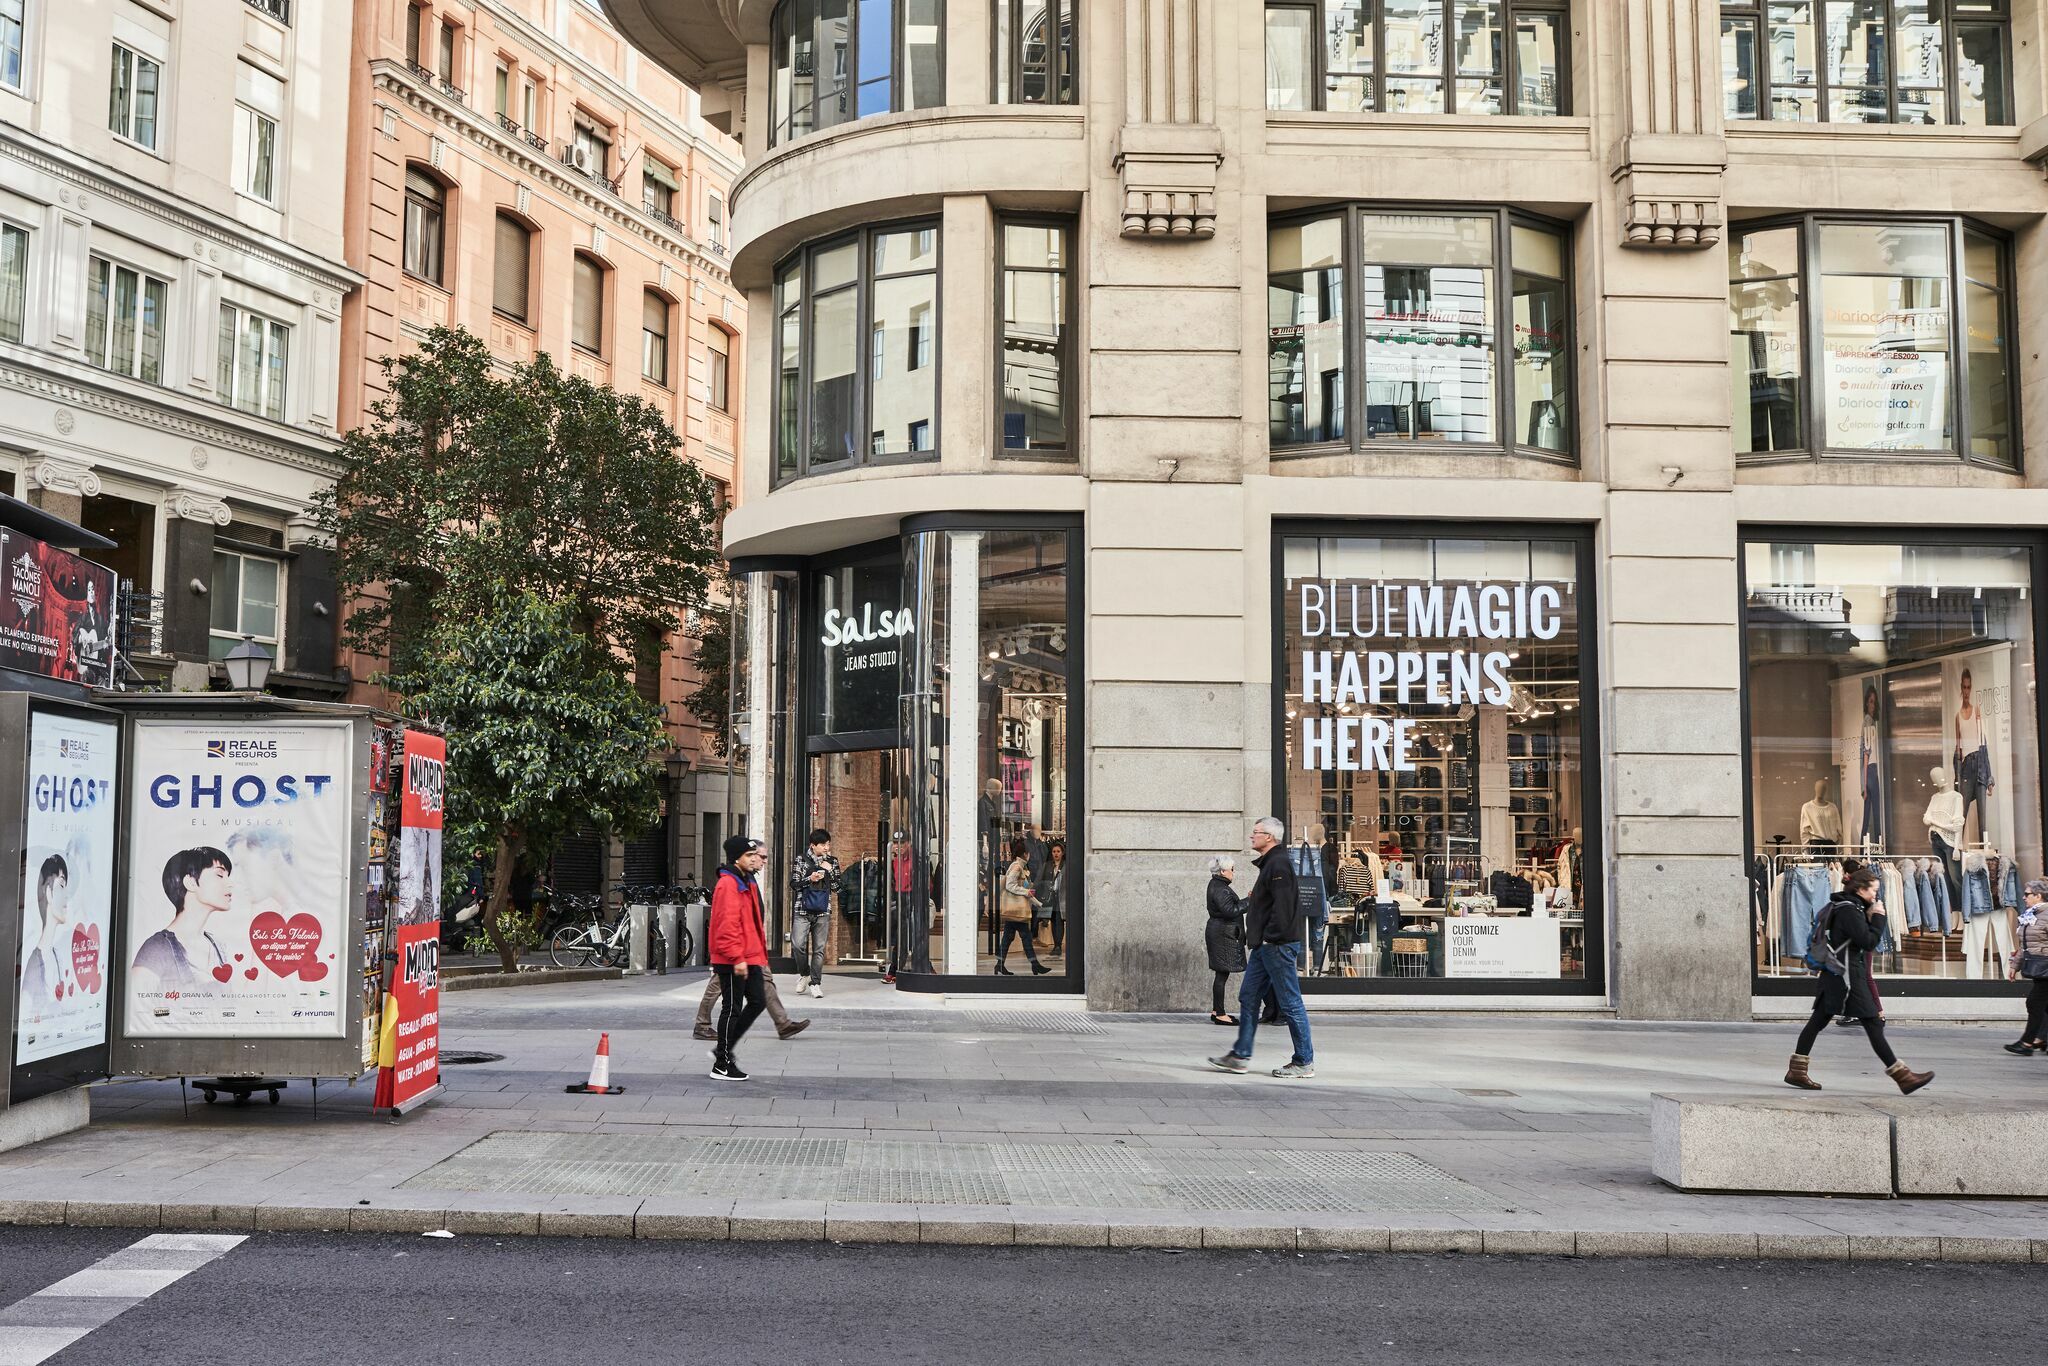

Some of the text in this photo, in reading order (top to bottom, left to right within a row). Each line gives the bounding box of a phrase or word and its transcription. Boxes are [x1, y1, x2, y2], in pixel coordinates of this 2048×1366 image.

[1835, 350, 1920, 361] EMPRENDEDORES2020
[1850, 381, 1924, 391] madridiario.es
[12, 565, 41, 583] TACONES
[12, 578, 40, 597] MANOLI
[4, 628, 31, 641] FLAMENCO
[31, 634, 59, 647] EXPERIENCE
[12, 640, 20, 650] NO
[20, 643, 37, 654] OTHER
[37, 647, 44, 655] IN
[43, 648, 58, 658] SPAIN
[844, 650, 897, 672] JEANS STUDIO
[1302, 651, 1511, 706] HAPPENS
[1975, 685, 2010, 717] PUSH
[69, 740, 89, 752] REALE
[229, 740, 278, 751] REALE
[1303, 717, 1416, 771] HERE
[69, 752, 89, 760] SEGUROS
[228, 751, 278, 759] SEGUROS
[36, 774, 109, 812] GHOST
[150, 774, 331, 809] GHOST
[191, 818, 294, 826] EL MUSICAL
[252, 929, 269, 939] Este
[270, 928, 287, 940] San
[1452, 925, 1499, 935] CUSTOMIZE
[1452, 937, 1474, 946] YOUR
[1452, 947, 1477, 957] DENIM
[201, 991, 214, 999] VÍA
